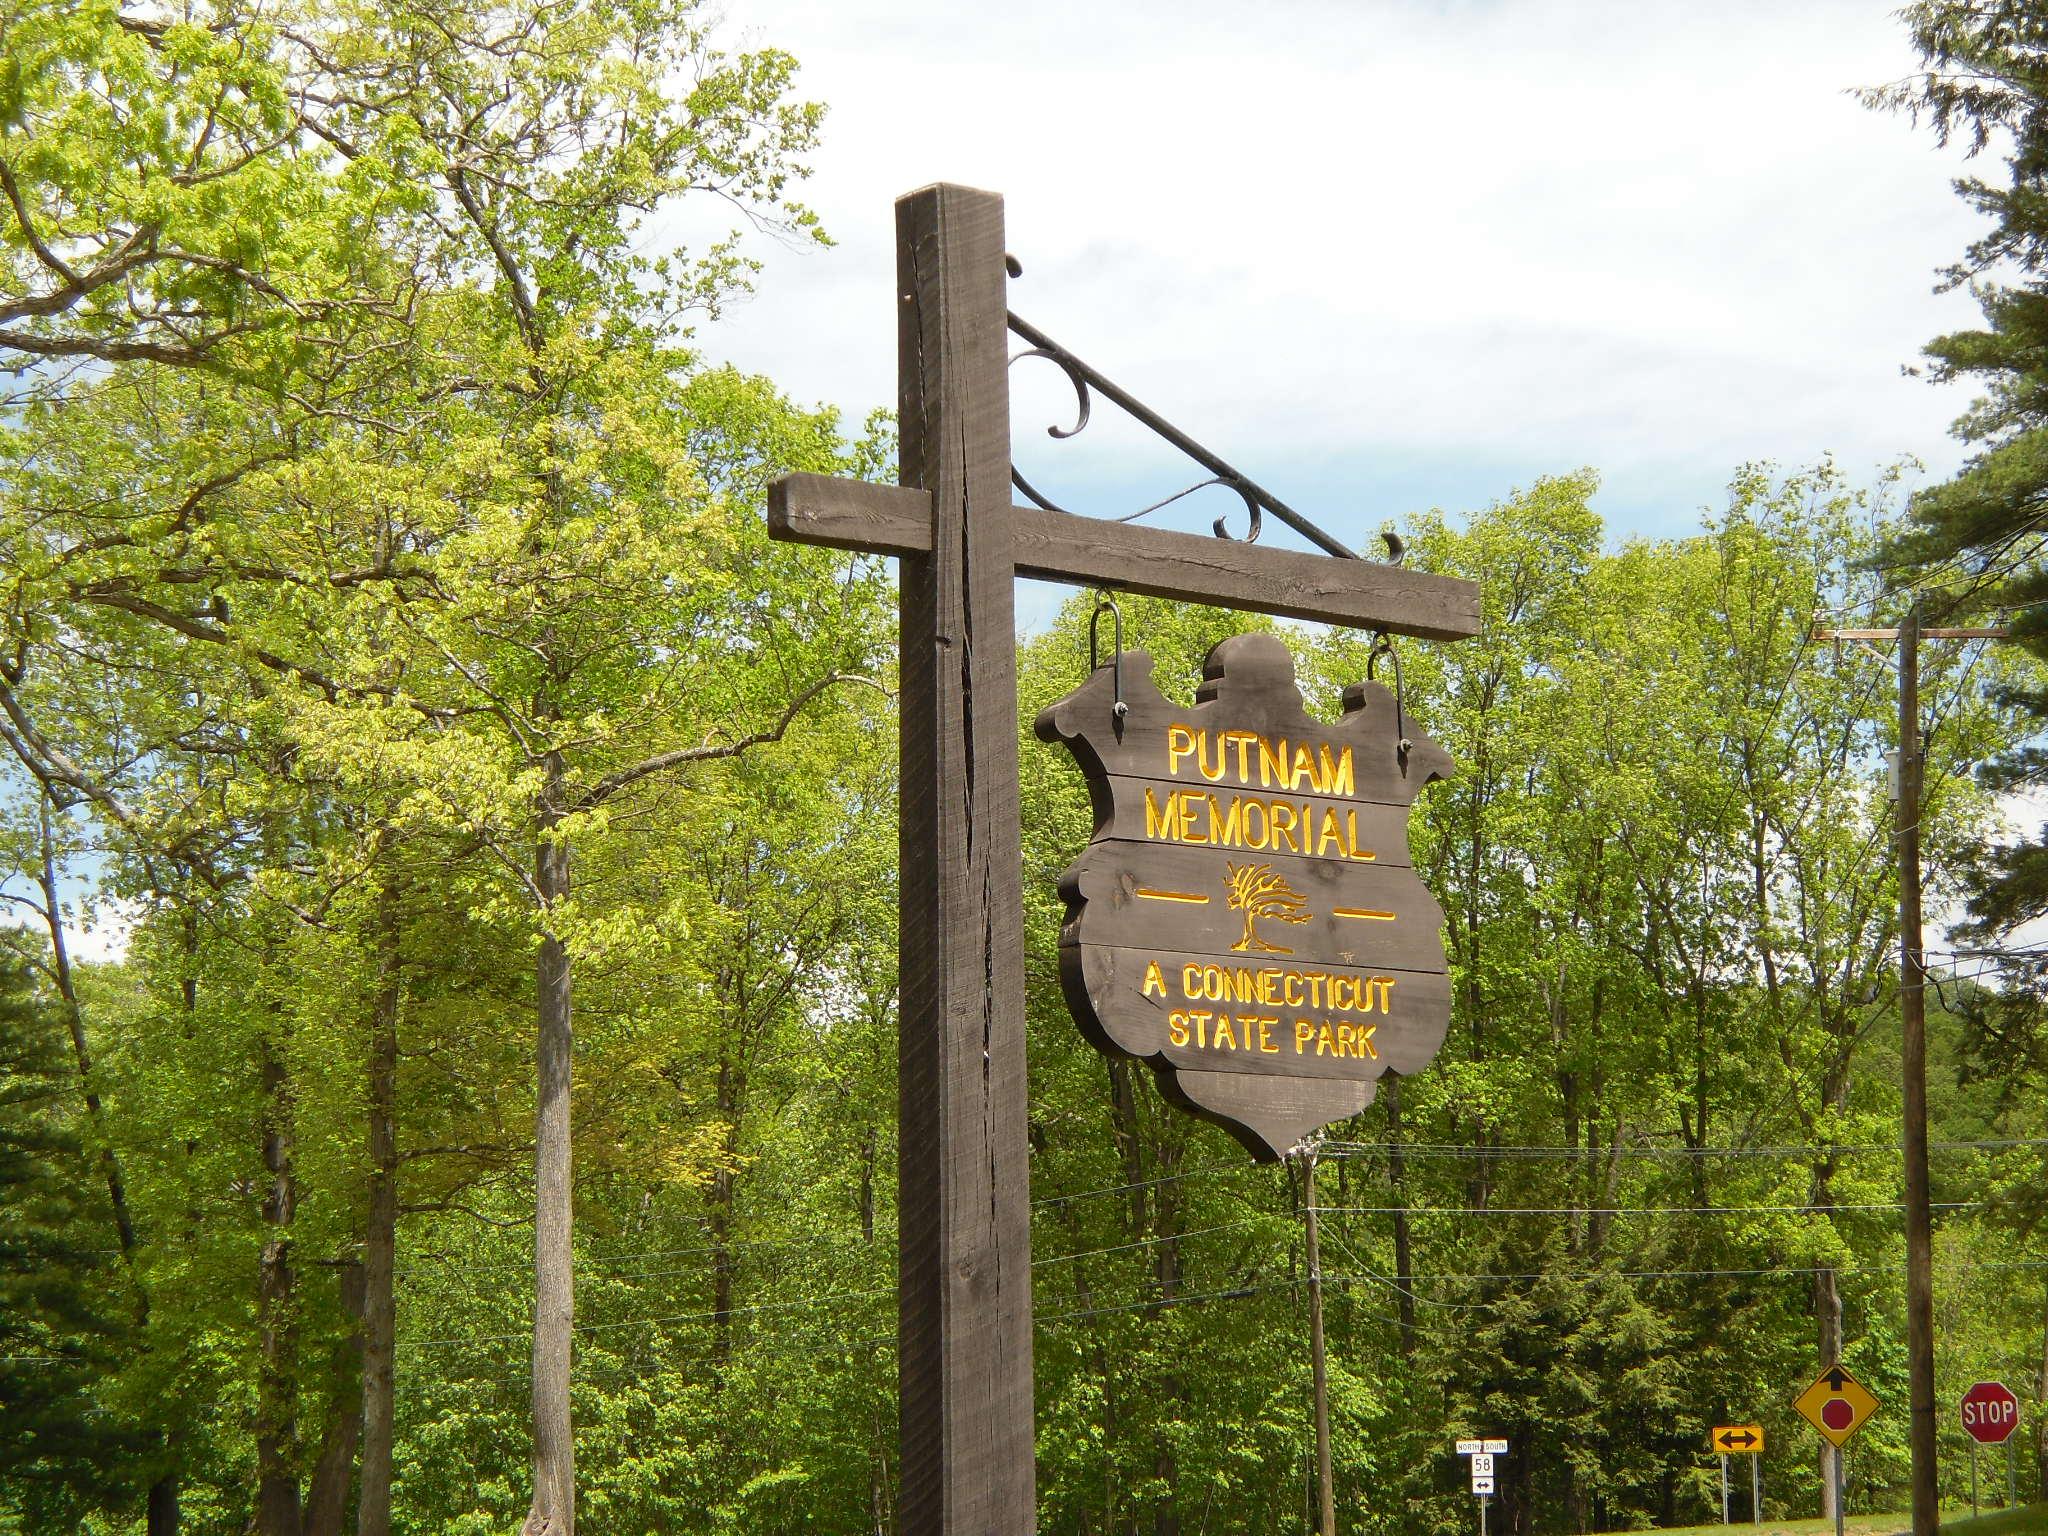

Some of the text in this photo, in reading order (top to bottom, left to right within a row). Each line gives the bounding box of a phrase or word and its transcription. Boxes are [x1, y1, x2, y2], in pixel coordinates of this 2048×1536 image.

[1167, 722, 1355, 797] PUTNAM
[1144, 786, 1376, 862] MEMORIAL
[1142, 960, 1397, 1015] A CONNECTICUT
[1168, 1008, 1379, 1060] STATE PARK
[1963, 1401, 2014, 1425] STOP
[1458, 1442, 1507, 1451] NORTH SOUTH
[1475, 1458, 1490, 1471] 58
